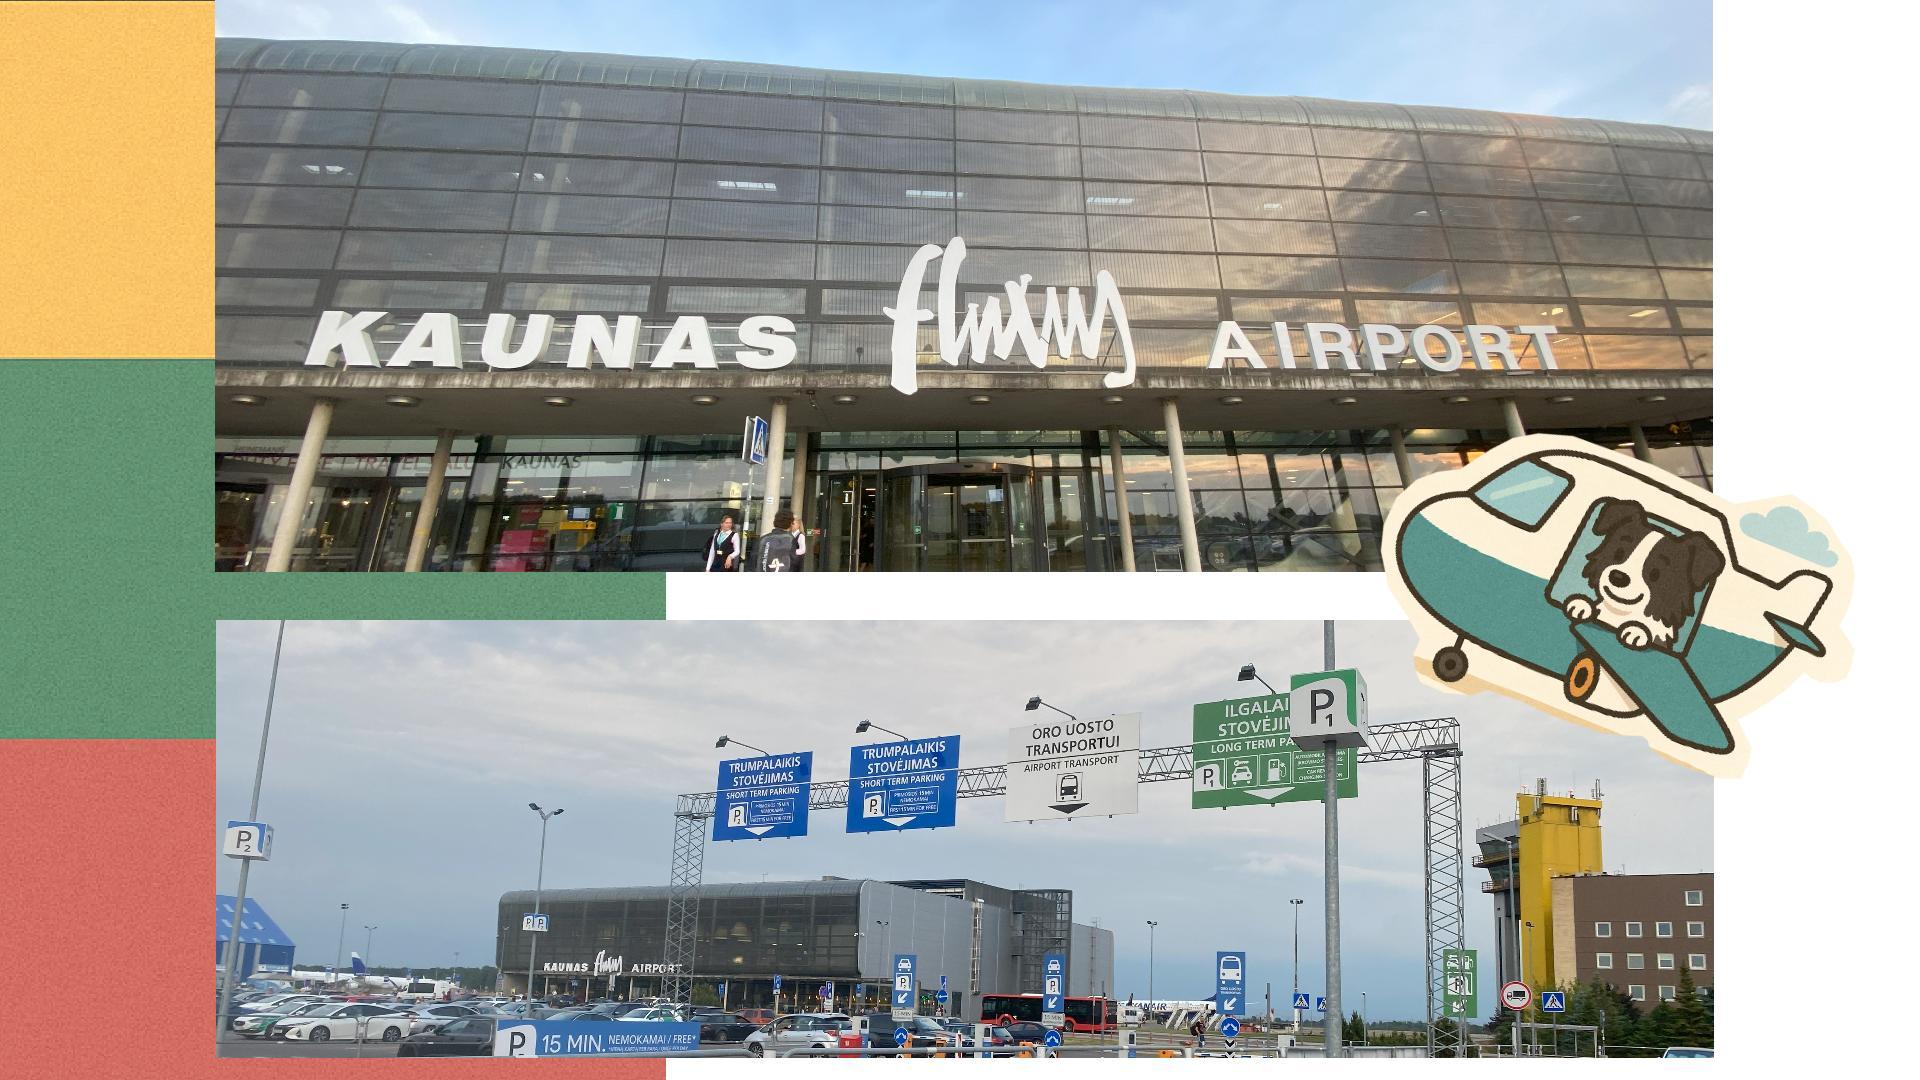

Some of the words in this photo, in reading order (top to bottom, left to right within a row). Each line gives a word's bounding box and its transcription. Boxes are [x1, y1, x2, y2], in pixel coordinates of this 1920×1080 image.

[305, 310, 797, 371] KAUNAS
[1207, 320, 1559, 373] AIRPORT
[355, 456, 424, 470] TRAEL
[502, 455, 582, 470] KAUNAS
[1225, 697, 1289, 718] ILGALAI
[1032, 726, 1061, 739] ORO
[1066, 719, 1114, 736] UOSTO
[1218, 714, 1291, 737] STOVĖJI
[862, 740, 946, 760] TRUMPALAIKIS
[1026, 735, 1120, 757] TRANSPORTUI
[1211, 742, 1242, 754] LONG
[1244, 738, 1276, 750] TERM
[729, 757, 801, 773] TRUMPALAIKIS
[867, 757, 938, 774] STOVĖJIMAS
[1023, 761, 1062, 772] AIRPORT
[1064, 755, 1119, 769] TRANSPORT
[733, 771, 794, 787] STOVĖJIMAS
[860, 779, 885, 788] SHORT
[888, 777, 909, 786] TERM
[910, 773, 945, 784] PARKING
[726, 790, 748, 800] SHORT
[750, 789, 768, 798] TERM
[769, 786, 800, 796] PARKING
[543, 962, 589, 972] KAUNAS
[631, 963, 682, 973] AIRPORT
[541, 1034, 562, 1054] 15
[567, 1033, 606, 1053] MIN.
[608, 1034, 667, 1045] NEMOKAMAI
